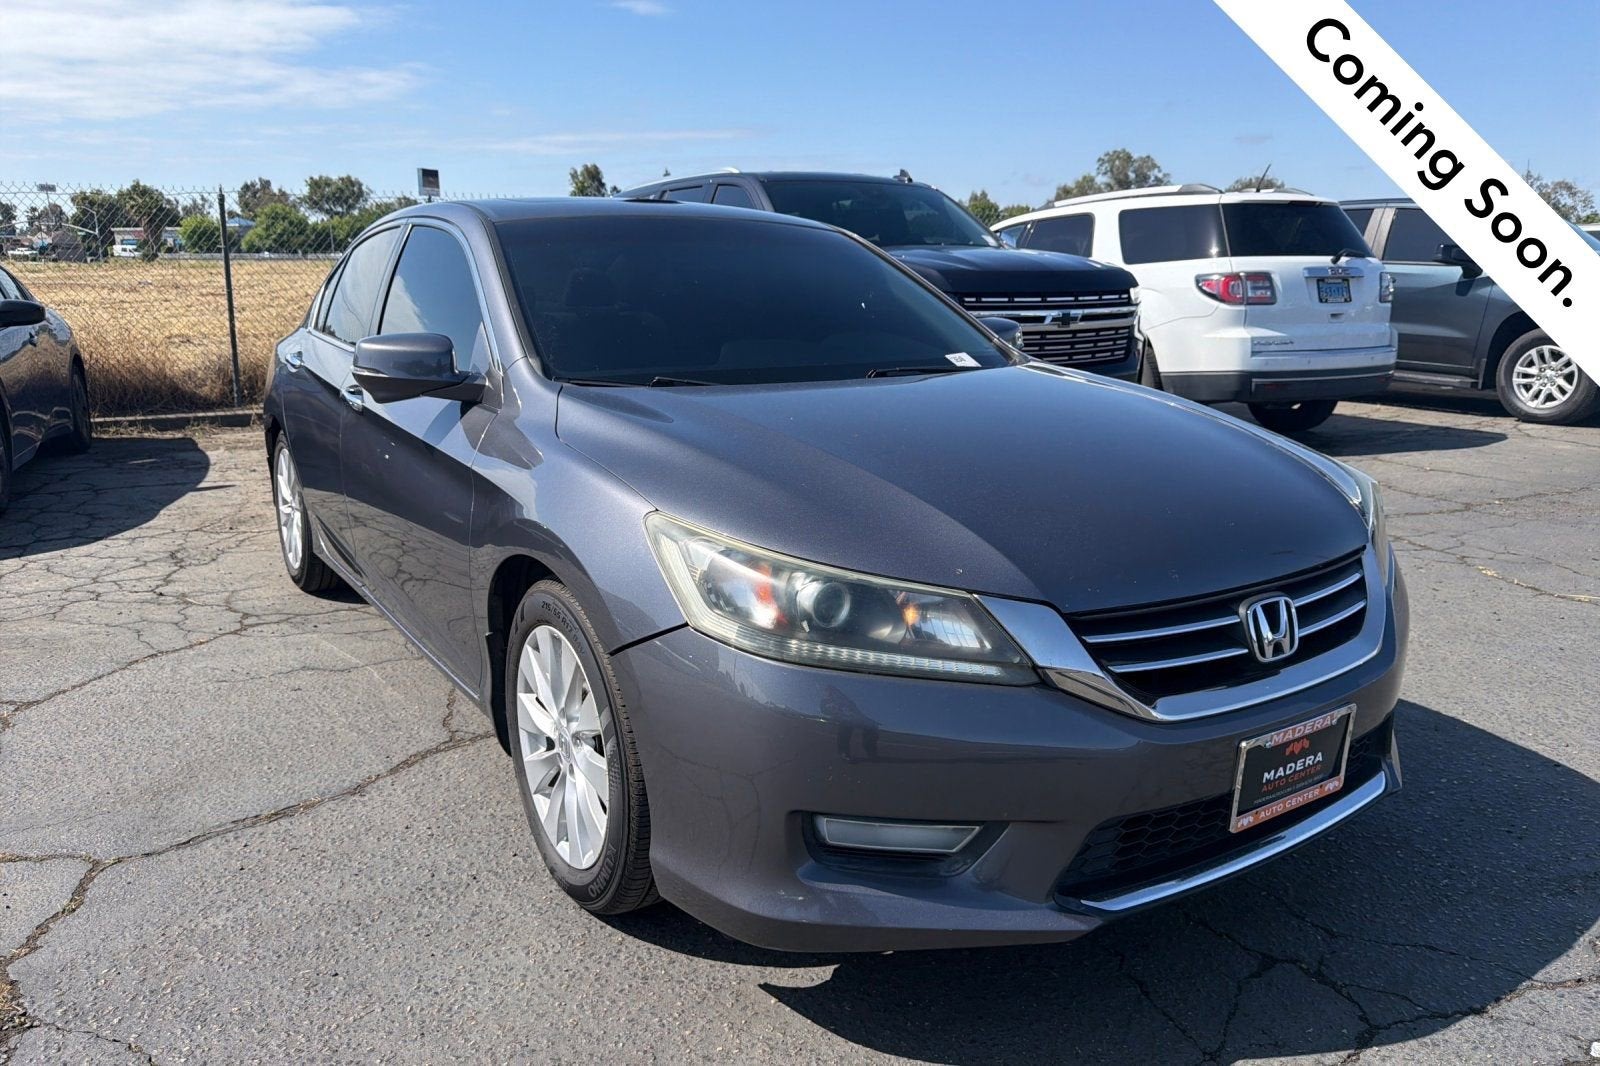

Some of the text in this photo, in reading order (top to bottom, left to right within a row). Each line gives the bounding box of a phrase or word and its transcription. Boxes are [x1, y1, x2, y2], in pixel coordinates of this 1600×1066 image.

[1271, 715, 1332, 745] MADERA
[1261, 778, 1286, 793] AUTO
[1288, 764, 1322, 783] CENTER
[1262, 751, 1323, 783] MADERA
[1259, 803, 1284, 820] AUTO
[1285, 788, 1320, 808] CENTER
